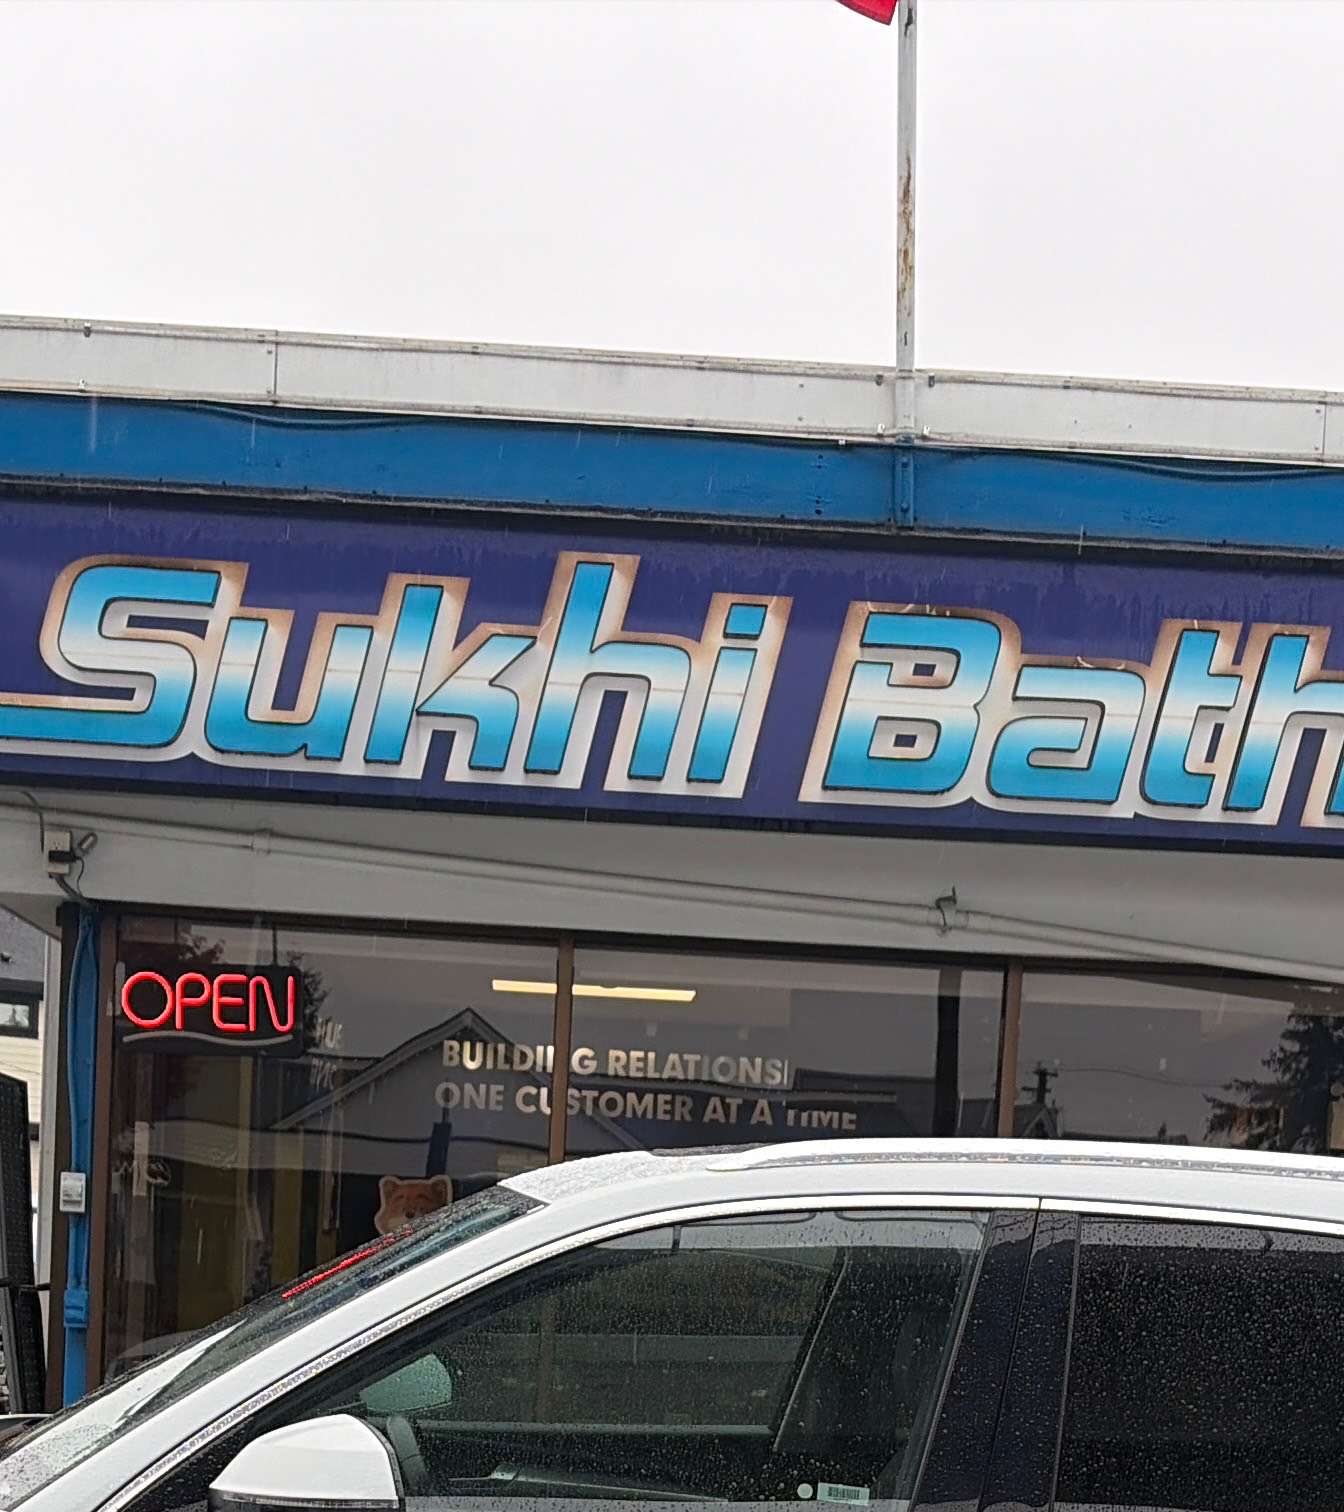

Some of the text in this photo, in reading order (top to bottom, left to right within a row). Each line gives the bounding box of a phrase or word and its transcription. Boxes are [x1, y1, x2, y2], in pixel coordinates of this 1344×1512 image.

[121, 971, 296, 1033] OPEN
[435, 1081, 505, 1112] ONE
[703, 1095, 744, 1125] AT
[749, 1098, 774, 1126] A
